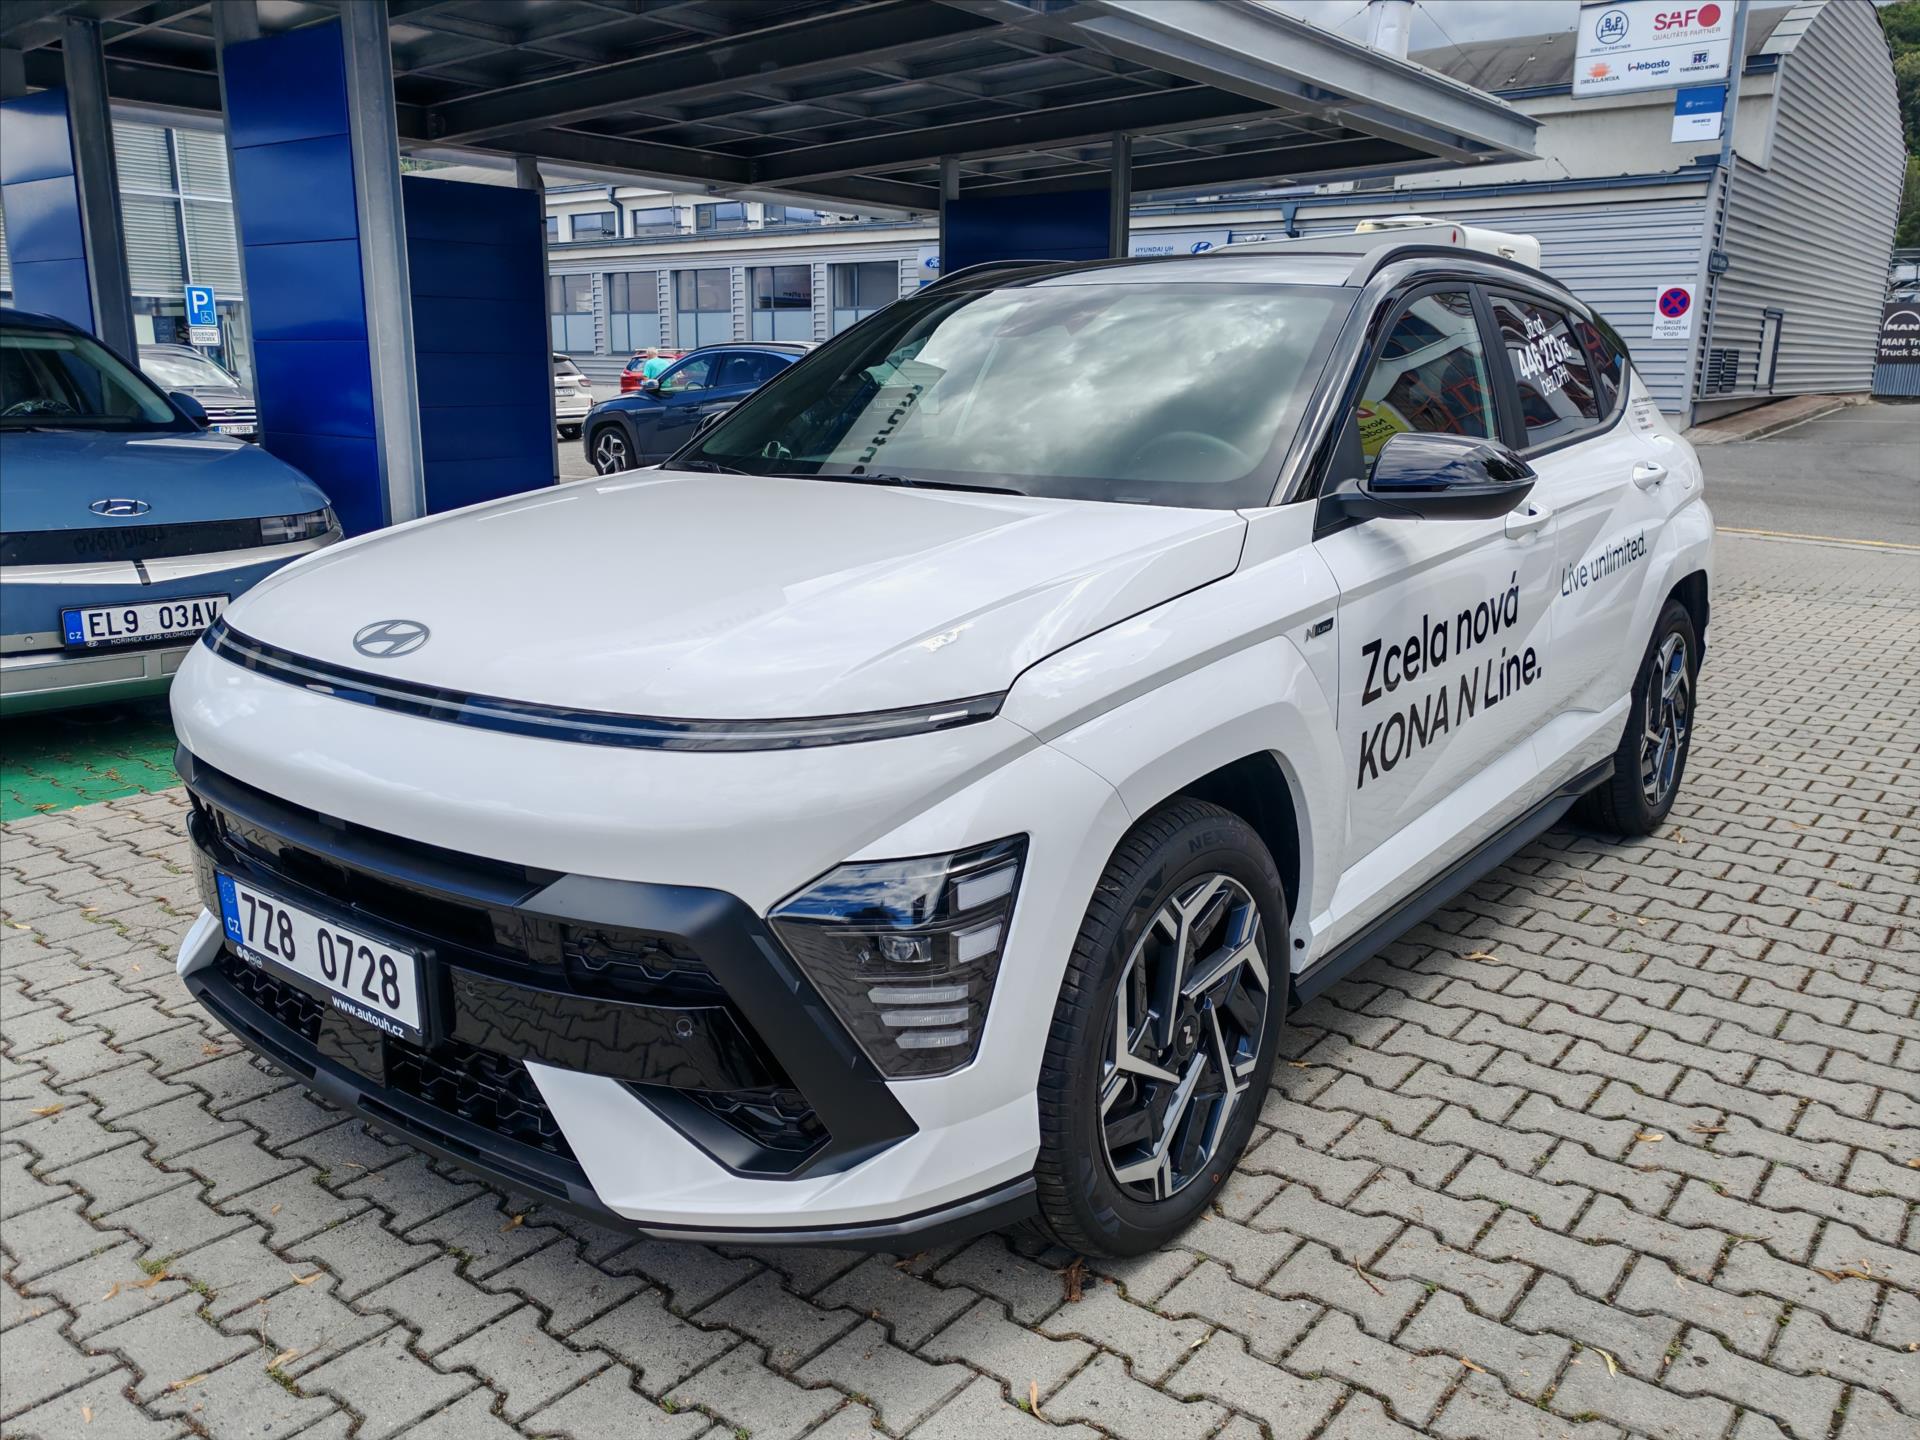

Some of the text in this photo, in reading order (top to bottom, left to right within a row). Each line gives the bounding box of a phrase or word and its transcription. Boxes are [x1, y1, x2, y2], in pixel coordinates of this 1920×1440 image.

[1689, 27, 1721, 36] PARTNER
[1680, 65, 1704, 73] THERMO
[192, 290, 208, 314] P
[1533, 313, 1546, 335] od
[1880, 348, 1909, 356] Truck
[1882, 338, 1906, 346] MAN
[1518, 342, 1545, 379] 446
[1539, 334, 1563, 368] 273
[1539, 363, 1570, 396] bez DPH
[1562, 528, 1647, 597] Live unlimited.
[89, 601, 218, 638] EL9 03AV
[69, 631, 83, 640] CZ
[111, 631, 197, 645] HORIMEX CARS OLOMOUC
[1361, 570, 1520, 706] Zcela nová
[1357, 647, 1542, 790] KONA N Line.
[227, 916, 241, 934] CZ
[241, 892, 401, 1010] 7Z8 0728
[332, 995, 405, 1038] www.autouh.cz
